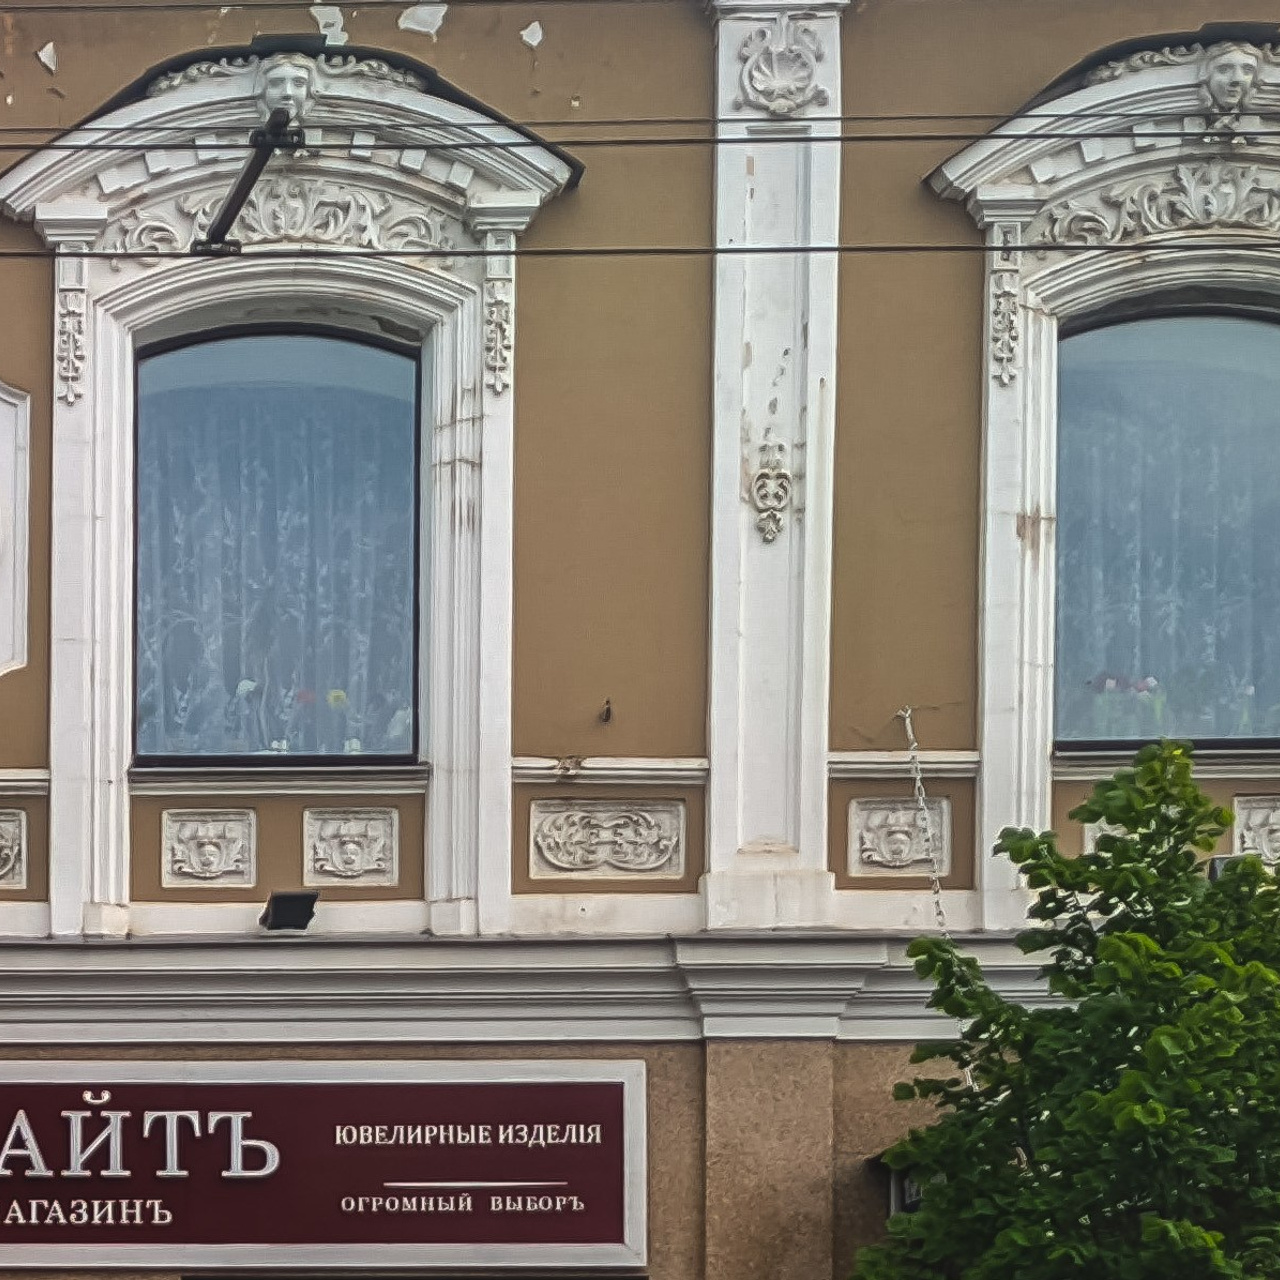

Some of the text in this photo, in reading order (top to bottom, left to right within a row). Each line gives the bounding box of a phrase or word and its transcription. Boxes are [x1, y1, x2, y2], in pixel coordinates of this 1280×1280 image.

[334, 1124, 492, 1146] ЮВЕЛИРНЫЕ
[340, 1192, 586, 1213] ОГРОМНЫЙ ВЫБОРЪ
